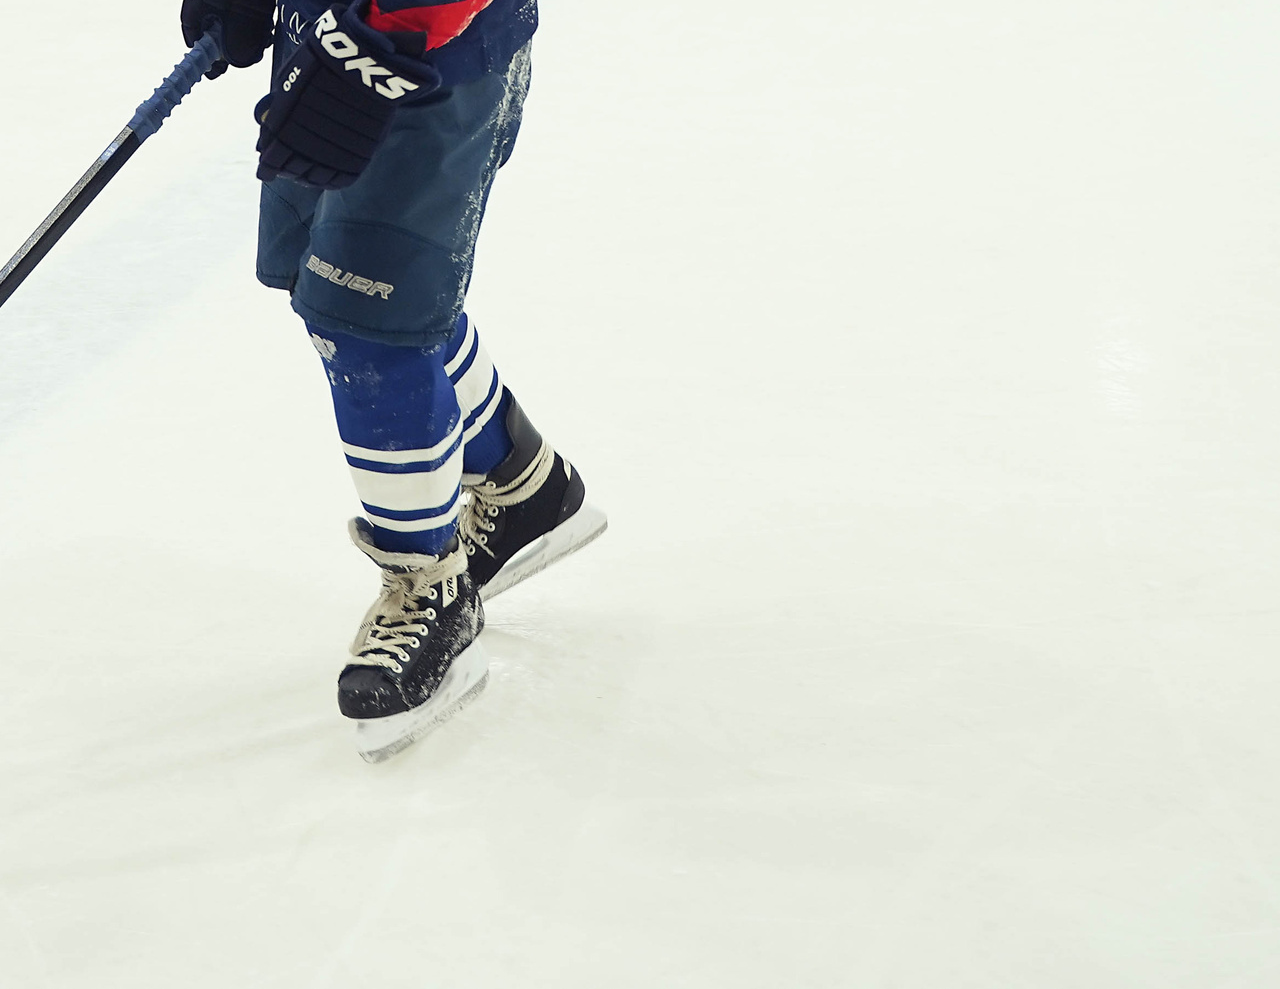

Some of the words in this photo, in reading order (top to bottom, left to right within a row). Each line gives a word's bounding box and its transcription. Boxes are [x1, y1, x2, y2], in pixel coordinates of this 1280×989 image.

[314, 9, 420, 100] ROKS
[282, 66, 302, 92] 100
[306, 254, 394, 301] BAUER
